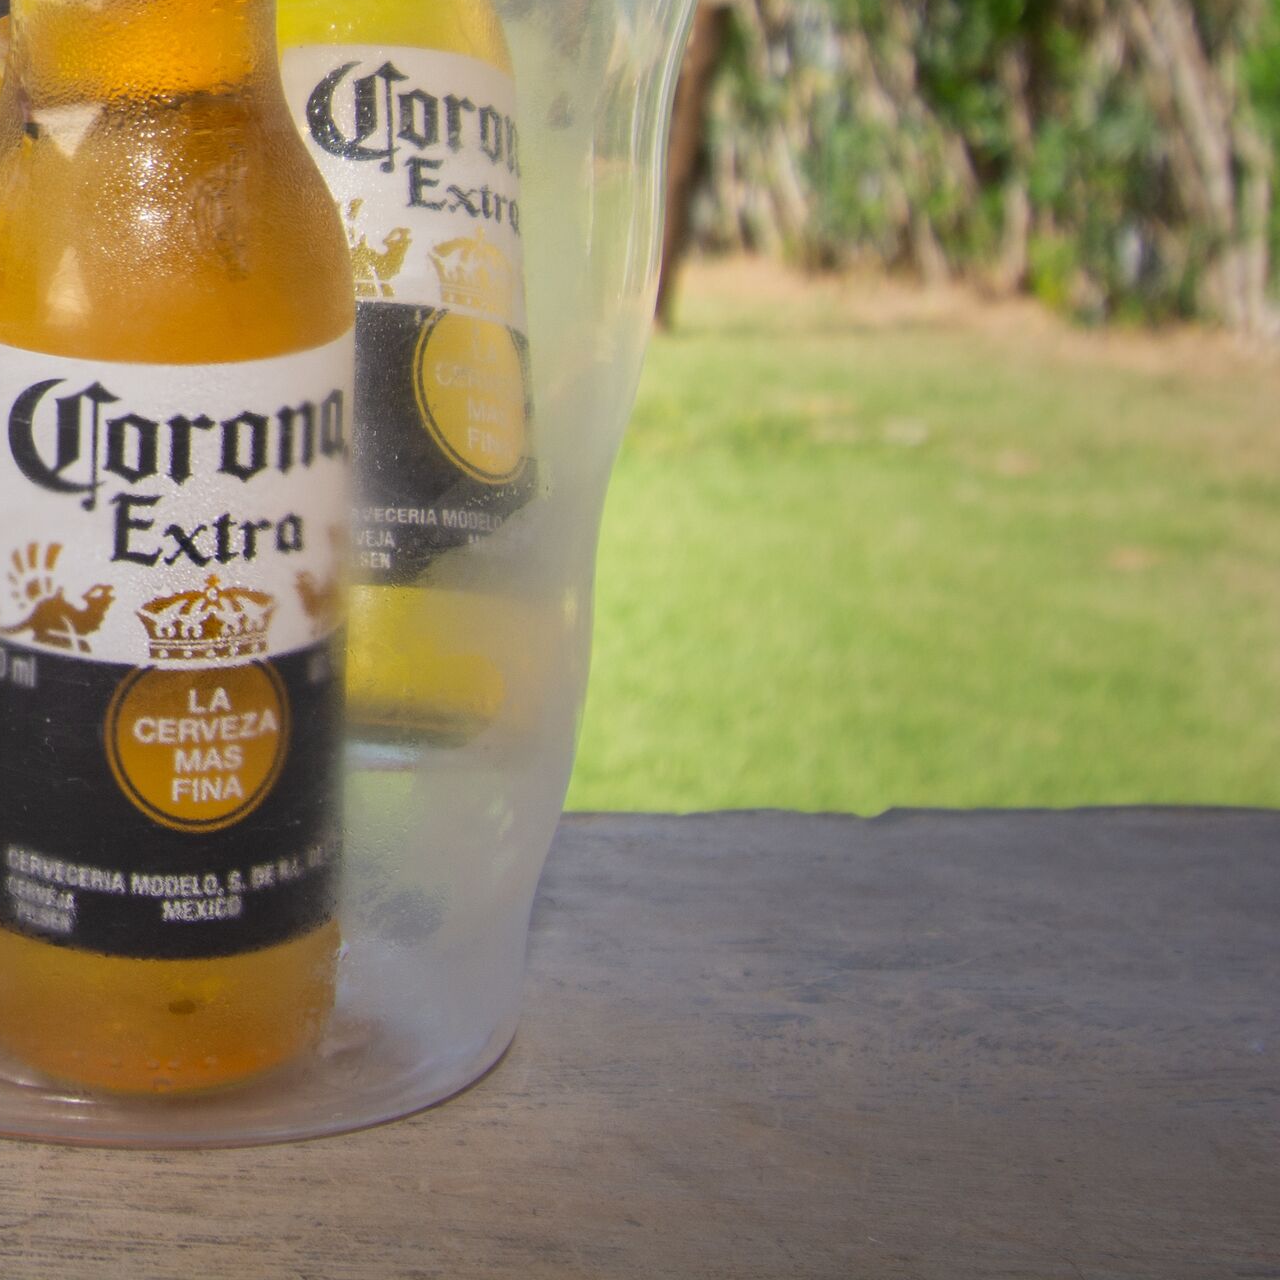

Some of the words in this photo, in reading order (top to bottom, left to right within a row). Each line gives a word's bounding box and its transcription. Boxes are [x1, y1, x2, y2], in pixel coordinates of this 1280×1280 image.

[7, 378, 346, 512] Corona
[110, 493, 305, 569] Extra
[12, 655, 36, 688] ml
[188, 686, 233, 714] LA
[133, 708, 279, 745] CERVEZA
[174, 744, 244, 773] MAS
[171, 774, 245, 804] FINA
[6, 845, 127, 894] CERVECERIA
[162, 894, 243, 921] MEXICO
